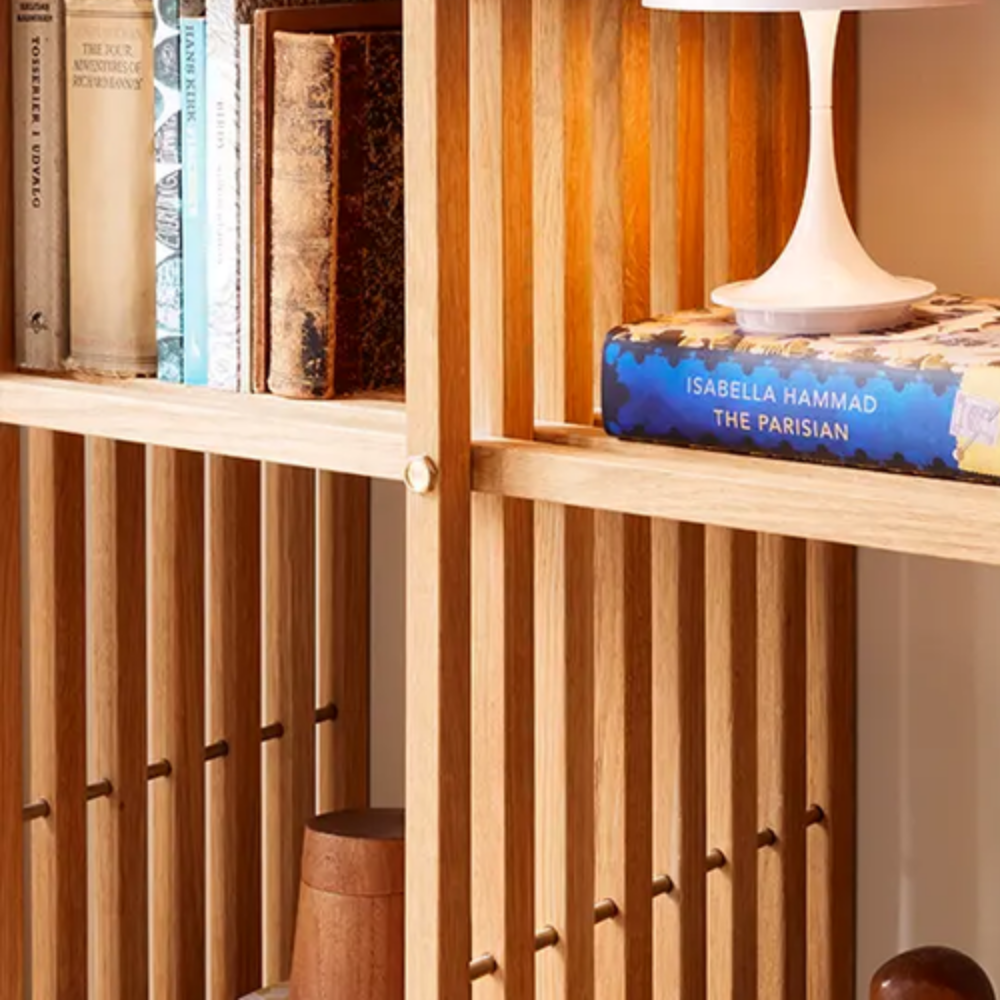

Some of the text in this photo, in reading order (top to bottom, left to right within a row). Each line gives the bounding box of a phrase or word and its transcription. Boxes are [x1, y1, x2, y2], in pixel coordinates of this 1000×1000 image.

[185, 24, 196, 69] HANS
[31, 35, 42, 123] TOSSERIER
[185, 75, 197, 123] KIRK
[686, 376, 878, 414] ISABELLA HAMMAD
[713, 408, 850, 441] THE PARISIAN
